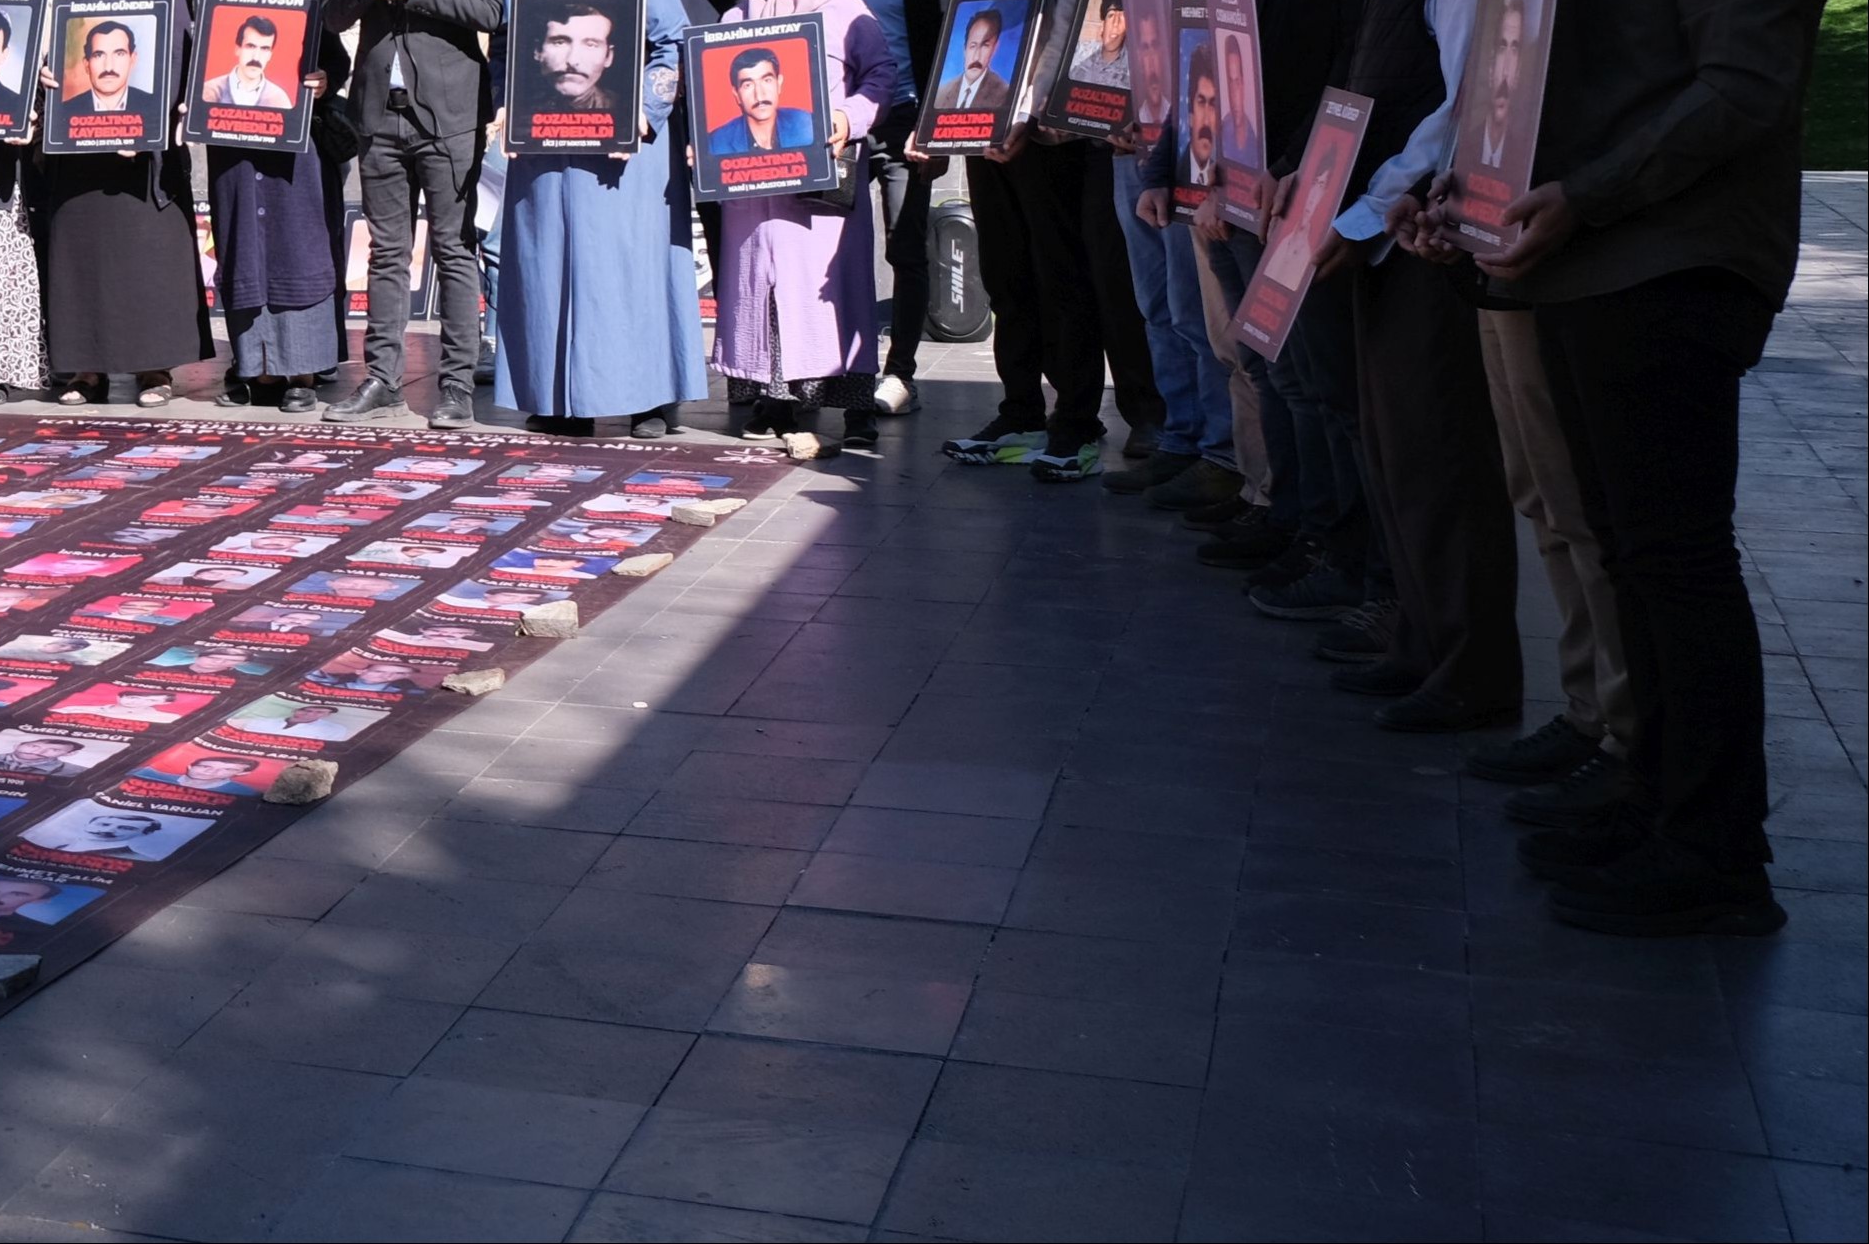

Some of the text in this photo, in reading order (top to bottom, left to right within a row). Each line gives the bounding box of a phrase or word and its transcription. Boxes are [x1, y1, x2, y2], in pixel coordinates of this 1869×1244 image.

[70, 0, 154, 13] İBRAHİM GÜNDEM
[703, 22, 802, 44] İBRAHİM KARTAY
[149, 802, 225, 817] VARUJAN
